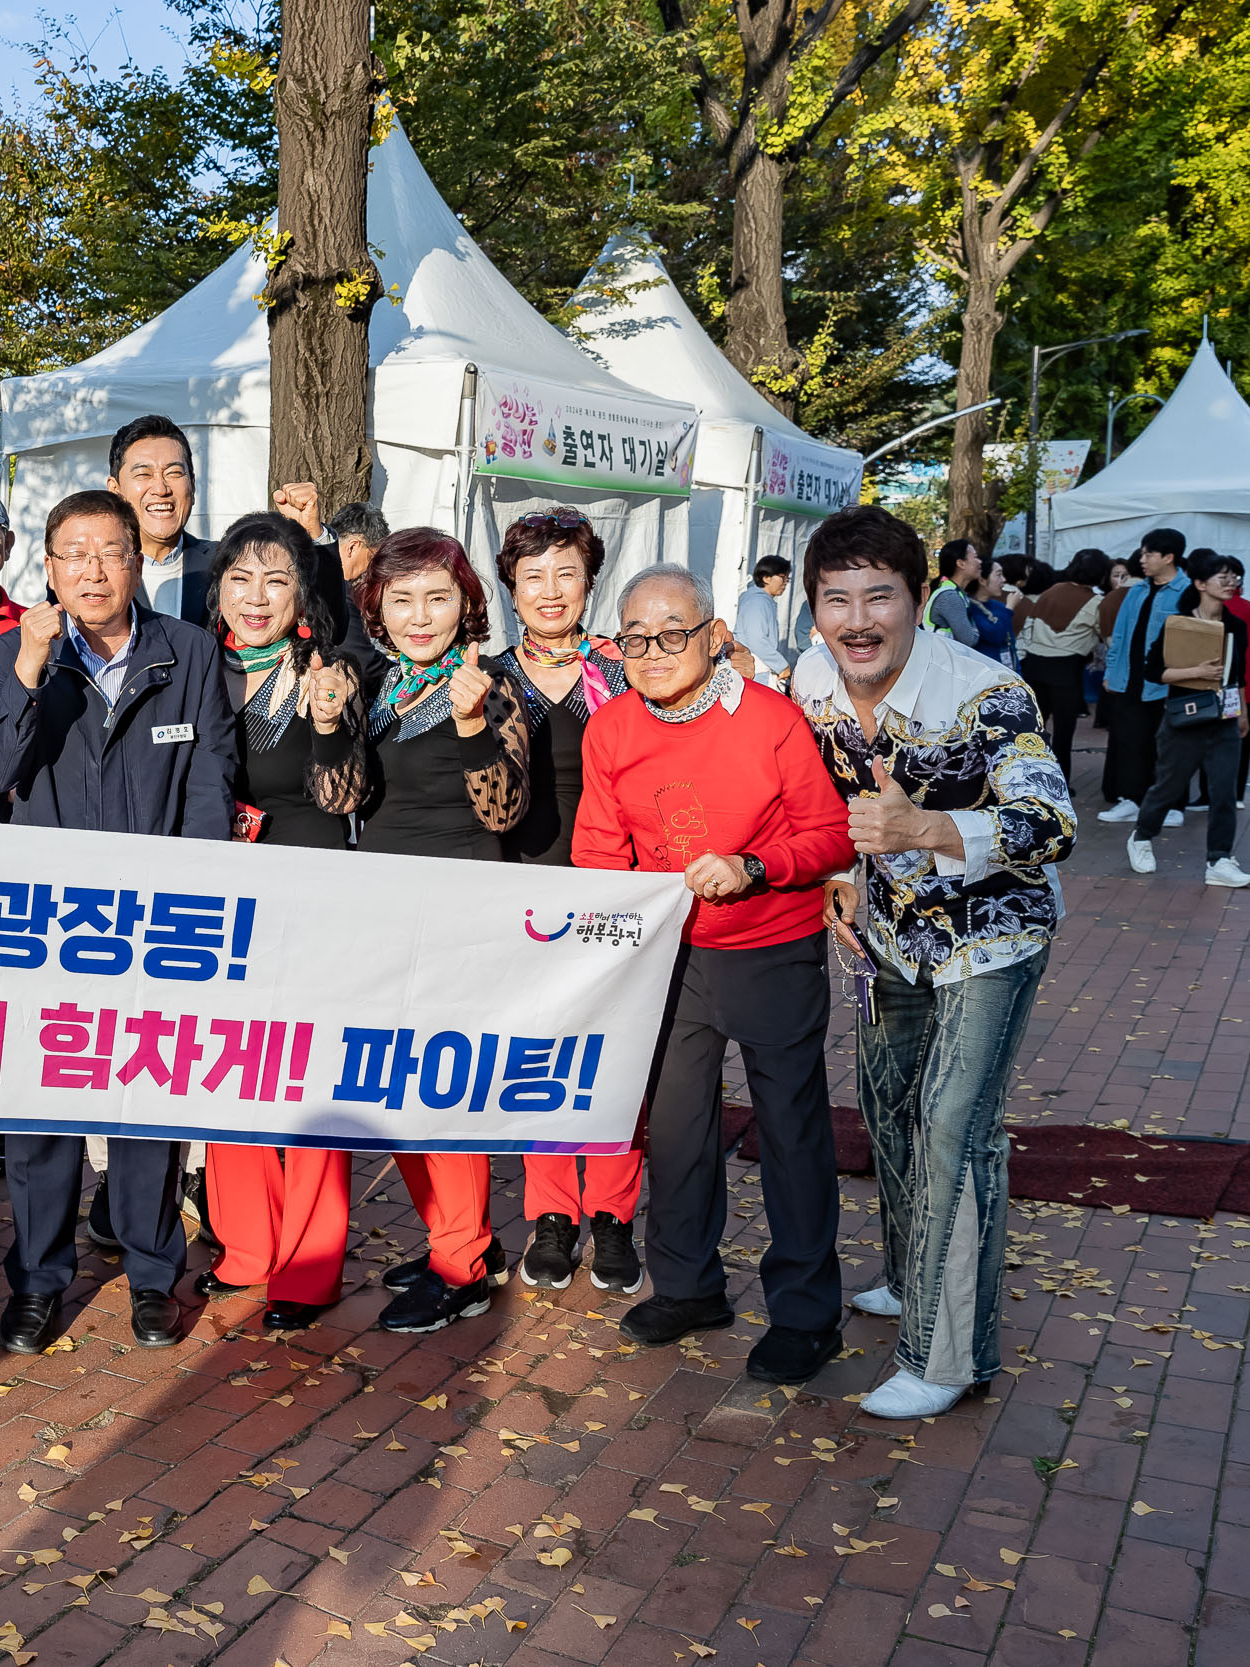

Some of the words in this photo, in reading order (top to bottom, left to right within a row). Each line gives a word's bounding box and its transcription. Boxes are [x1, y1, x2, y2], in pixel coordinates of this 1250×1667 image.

[501, 421, 533, 459] 광진
[561, 425, 613, 471] 출연자
[621, 436, 668, 477] 대기실
[797, 469, 821, 504] 출연자
[576, 922, 643, 947] 행복광진
[38, 1002, 315, 1102] 힘차게!
[331, 1026, 605, 1113] 파이팅!
